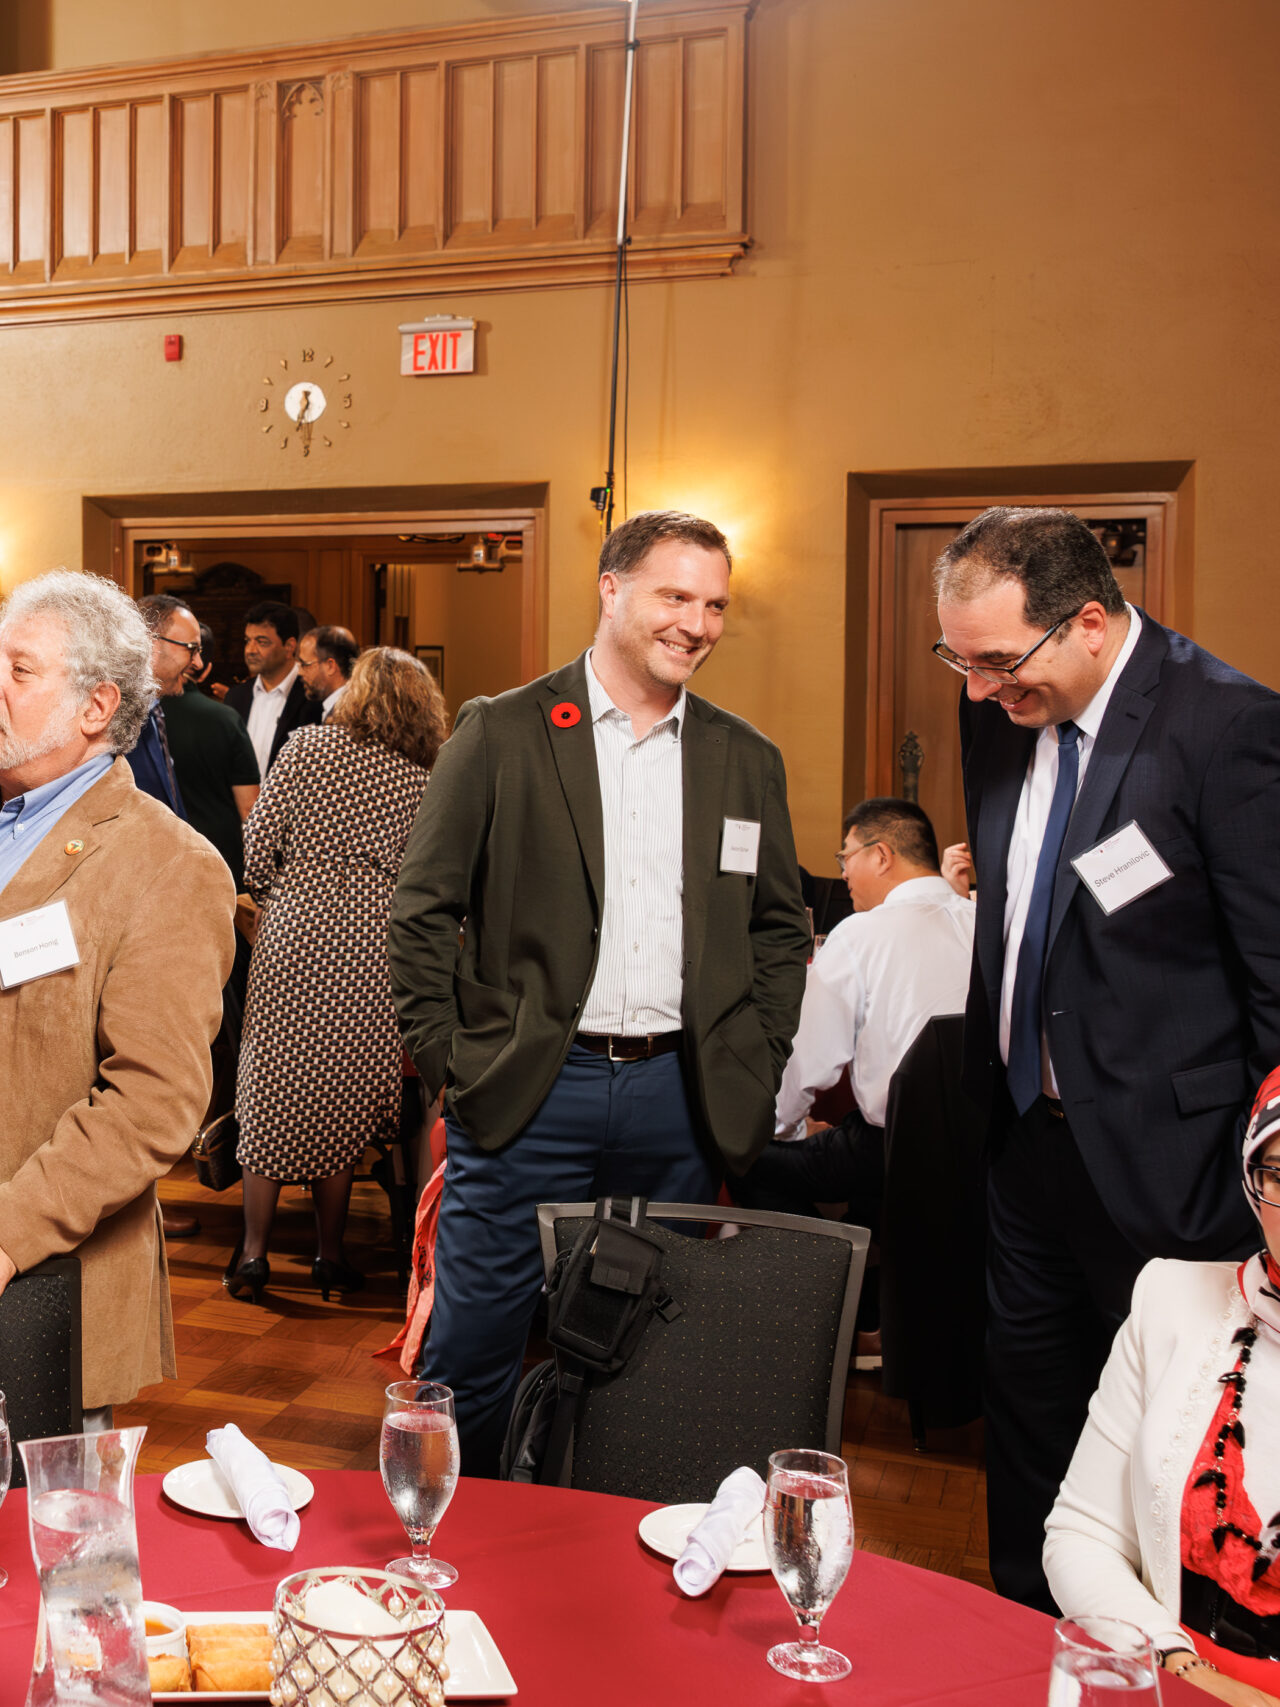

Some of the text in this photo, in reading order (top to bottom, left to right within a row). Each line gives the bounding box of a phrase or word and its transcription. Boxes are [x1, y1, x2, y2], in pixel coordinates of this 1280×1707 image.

[413, 332, 462, 371] EXIT
[1094, 849, 1151, 888] Steve Hranilovic
[14, 945, 39, 959] Benson
